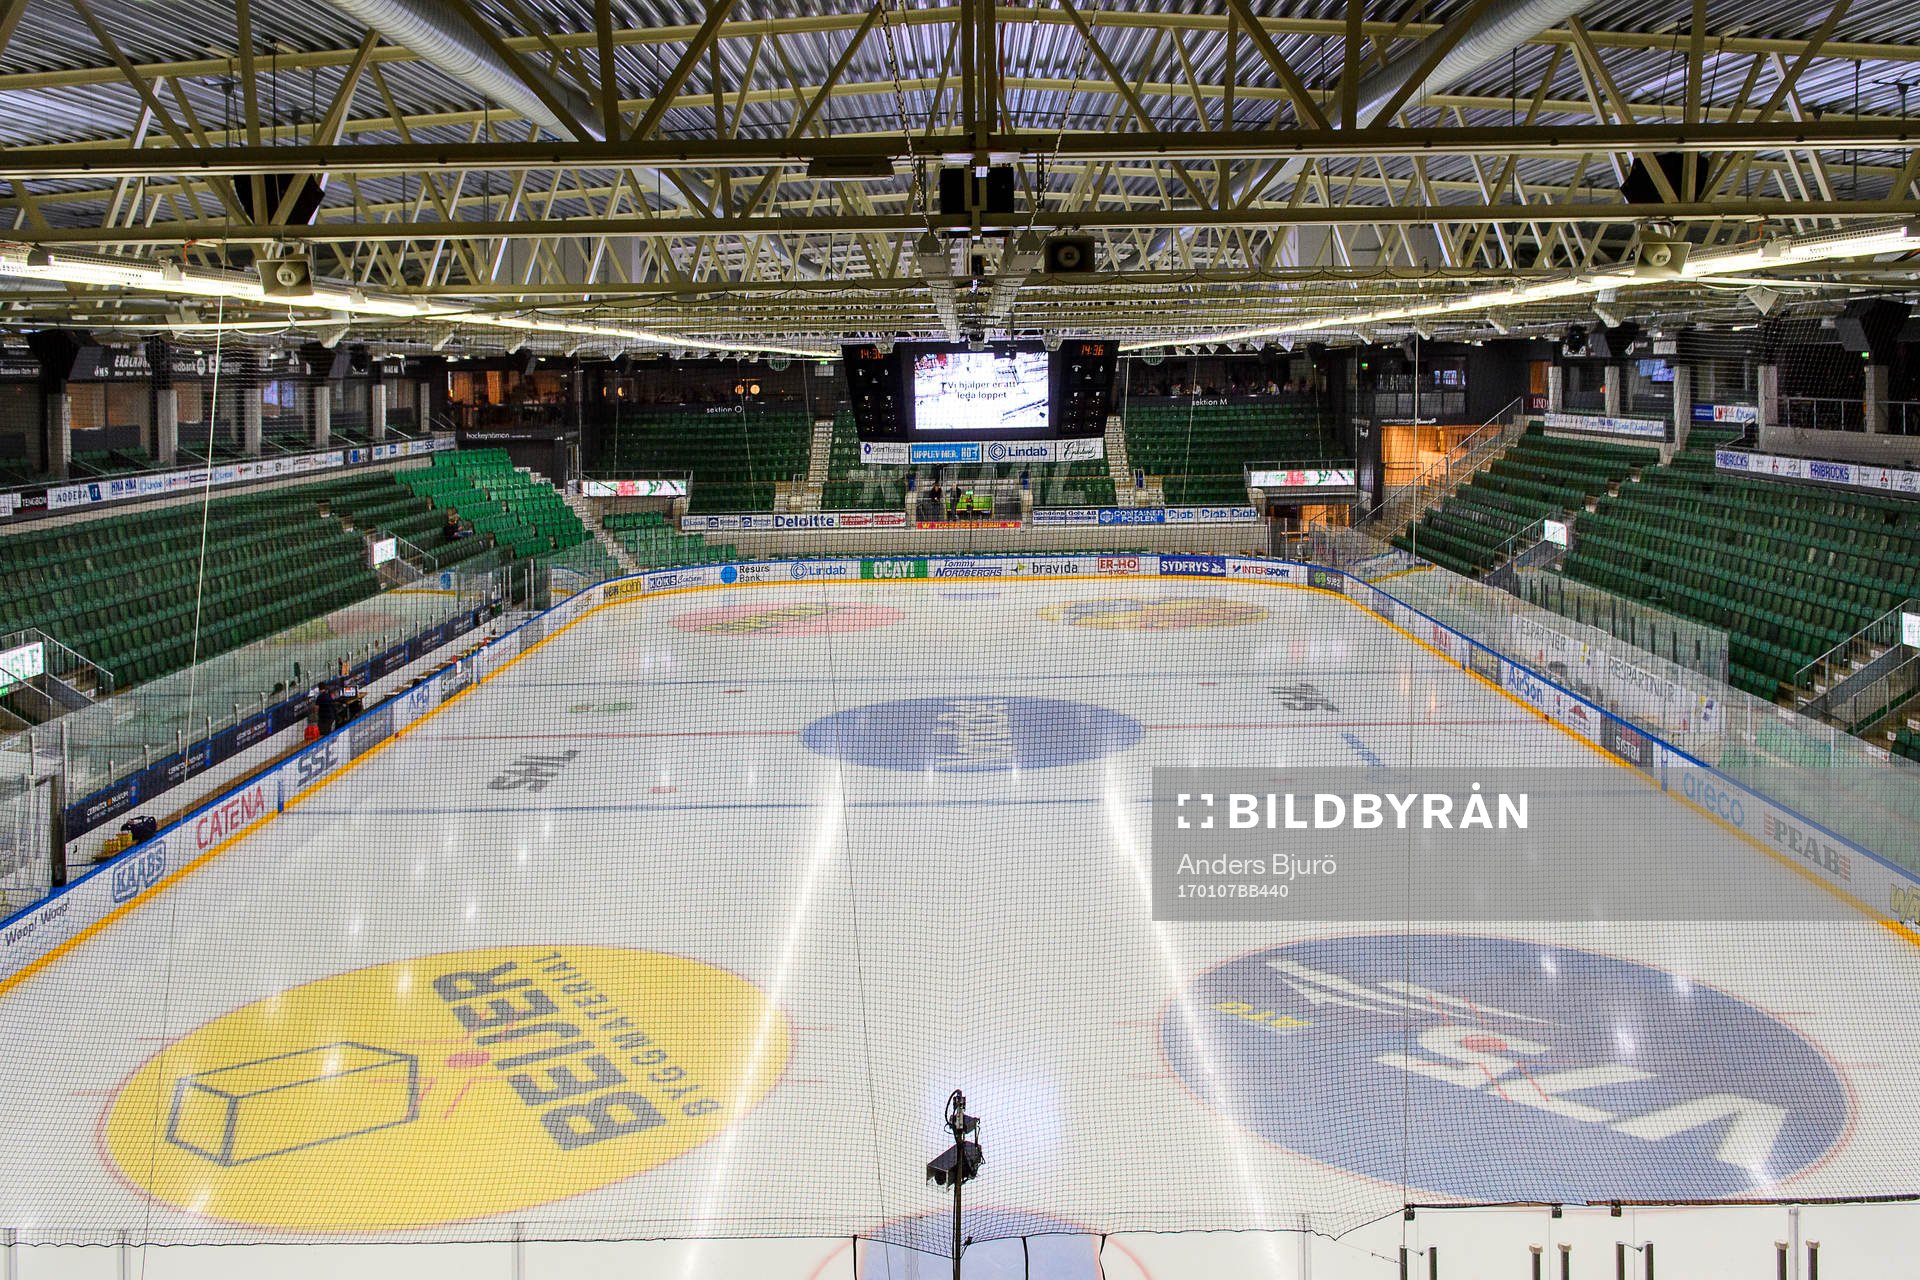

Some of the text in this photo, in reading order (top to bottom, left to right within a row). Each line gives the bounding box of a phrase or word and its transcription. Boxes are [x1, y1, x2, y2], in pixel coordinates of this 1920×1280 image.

[1081, 344, 1104, 355] 14:36
[977, 391, 1007, 401] loppet
[1192, 398, 1228, 406] sektion M
[913, 450, 940, 459] UPPLEV
[1008, 446, 1048, 457] Lindab
[739, 564, 770, 574] Resurs
[873, 561, 916, 579] OCAY!
[944, 560, 975, 569] Tommy
[1032, 561, 1078, 574] bravida
[1099, 559, 1138, 569] ER-HO
[1160, 560, 1209, 573] SYDFRYS
[739, 574, 762, 582] Bank
[935, 567, 1002, 578] NORDBERGHS
[1242, 565, 1289, 578] INTERSPORT
[297, 737, 338, 787] SSE
[195, 785, 265, 850] CATENA
[1773, 816, 1840, 876] PEAB
[116, 848, 163, 896] KAABS
[5, 897, 71, 946] Woop! Woop!
[533, 952, 722, 1117] BYGGMATERIAL
[432, 961, 667, 1150] BEIJER
